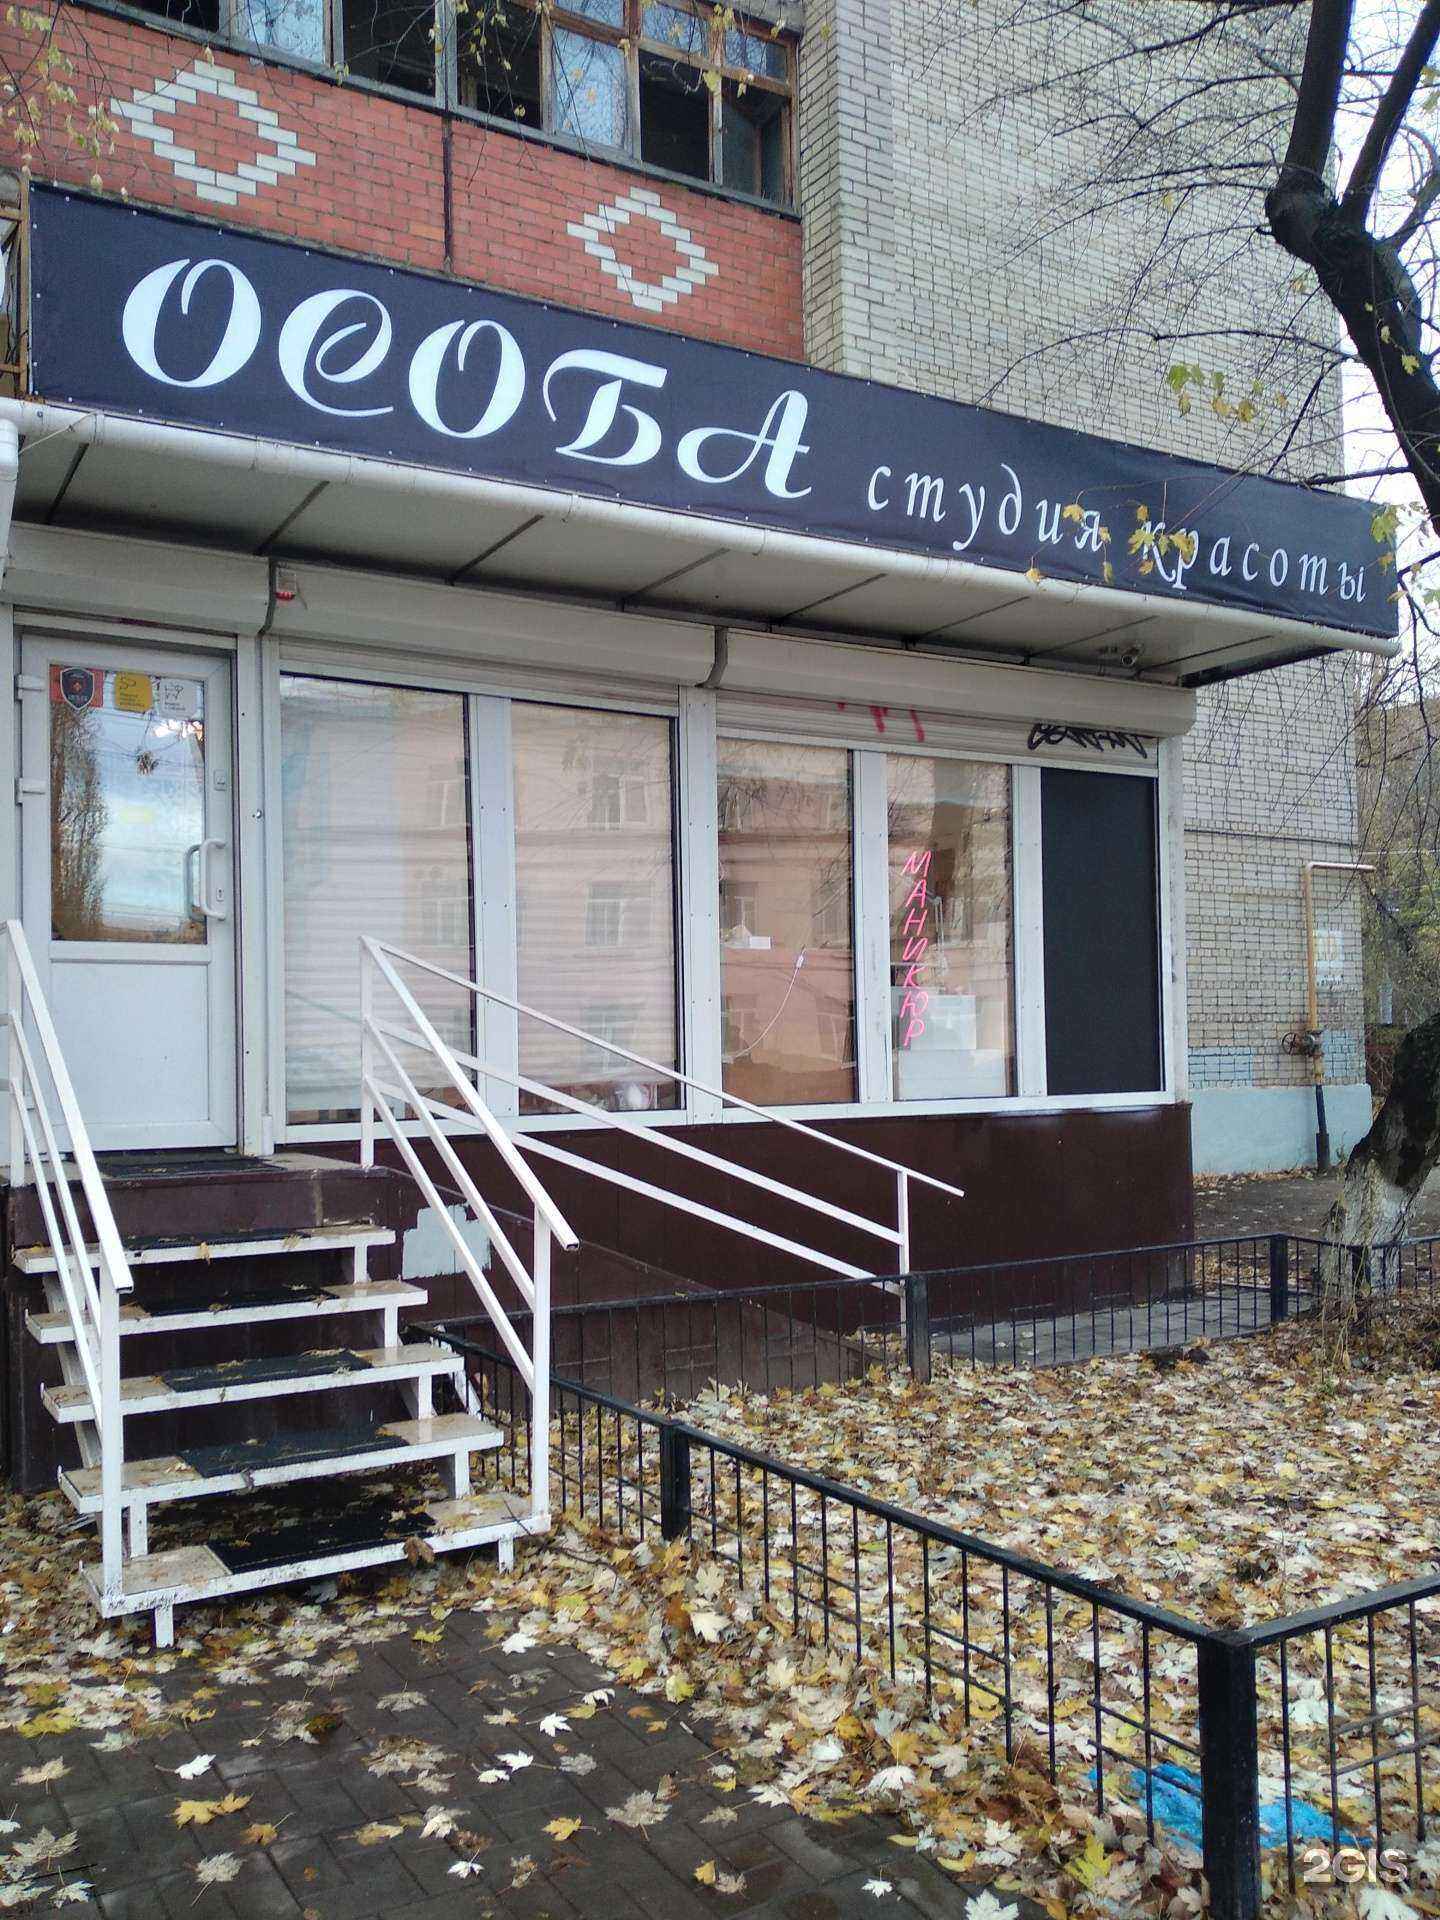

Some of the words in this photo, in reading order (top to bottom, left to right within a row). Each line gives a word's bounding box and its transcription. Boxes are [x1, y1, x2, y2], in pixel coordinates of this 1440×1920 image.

[122, 258, 812, 499] ОСОБА
[867, 463, 1103, 552] студия
[1140, 520, 1367, 603] красоты
[900, 850, 932, 1048] МАНИКЮР
